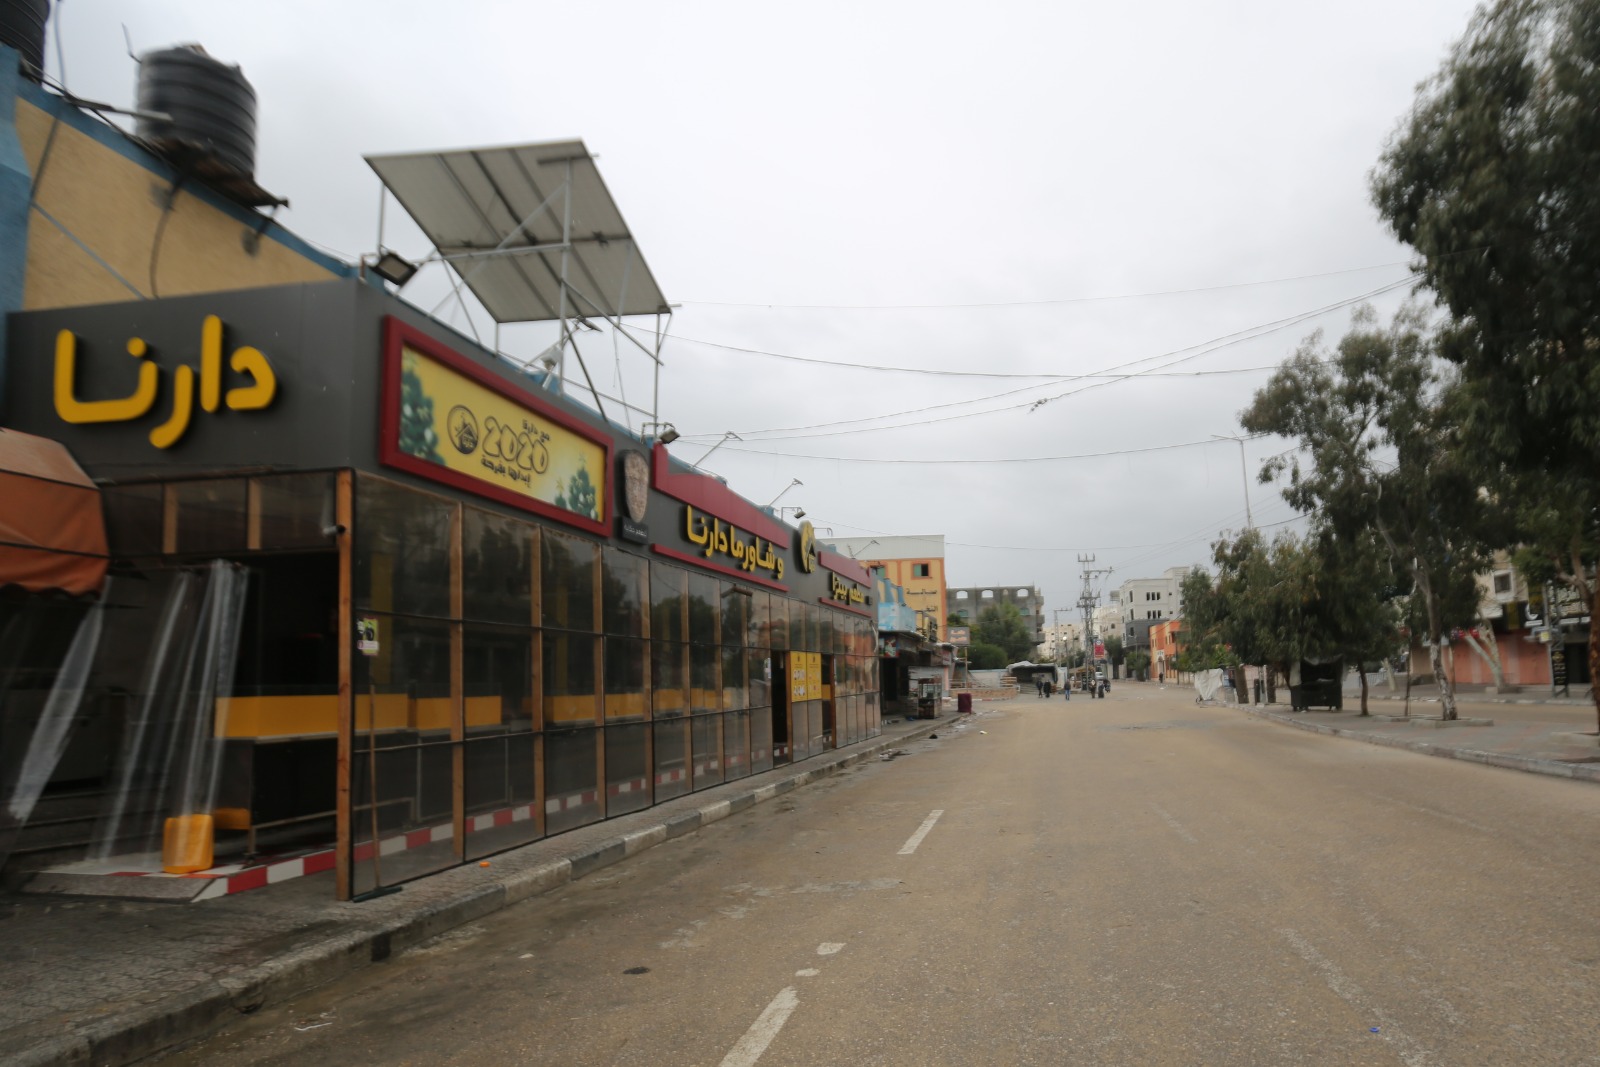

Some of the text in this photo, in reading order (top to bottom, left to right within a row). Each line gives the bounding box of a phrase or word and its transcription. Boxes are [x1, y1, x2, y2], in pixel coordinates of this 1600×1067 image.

[54, 314, 277, 449] دارنا
[483, 416, 549, 474] 2020
[687, 504, 729, 557] دارنا
[730, 525, 775, 572] شاورما
